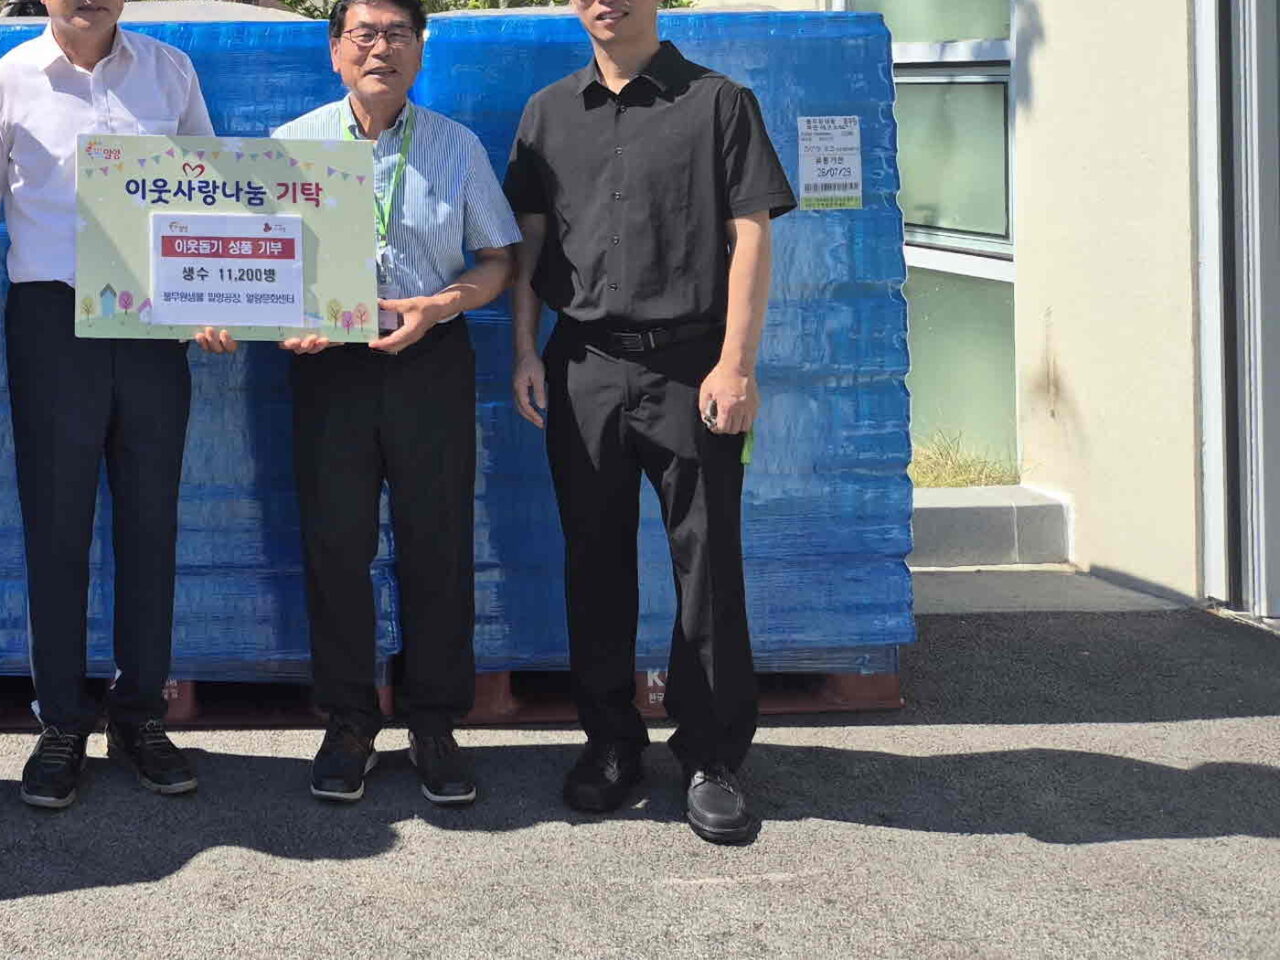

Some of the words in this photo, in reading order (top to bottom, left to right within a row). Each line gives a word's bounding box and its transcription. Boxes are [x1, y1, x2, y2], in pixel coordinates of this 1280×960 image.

[125, 177, 268, 206] 이웃사랑나눔
[276, 180, 324, 208] 기탁
[175, 239, 223, 255] 이웃돕기
[228, 240, 253, 255] 성품
[258, 241, 283, 256] 기부
[182, 266, 209, 281] 생수
